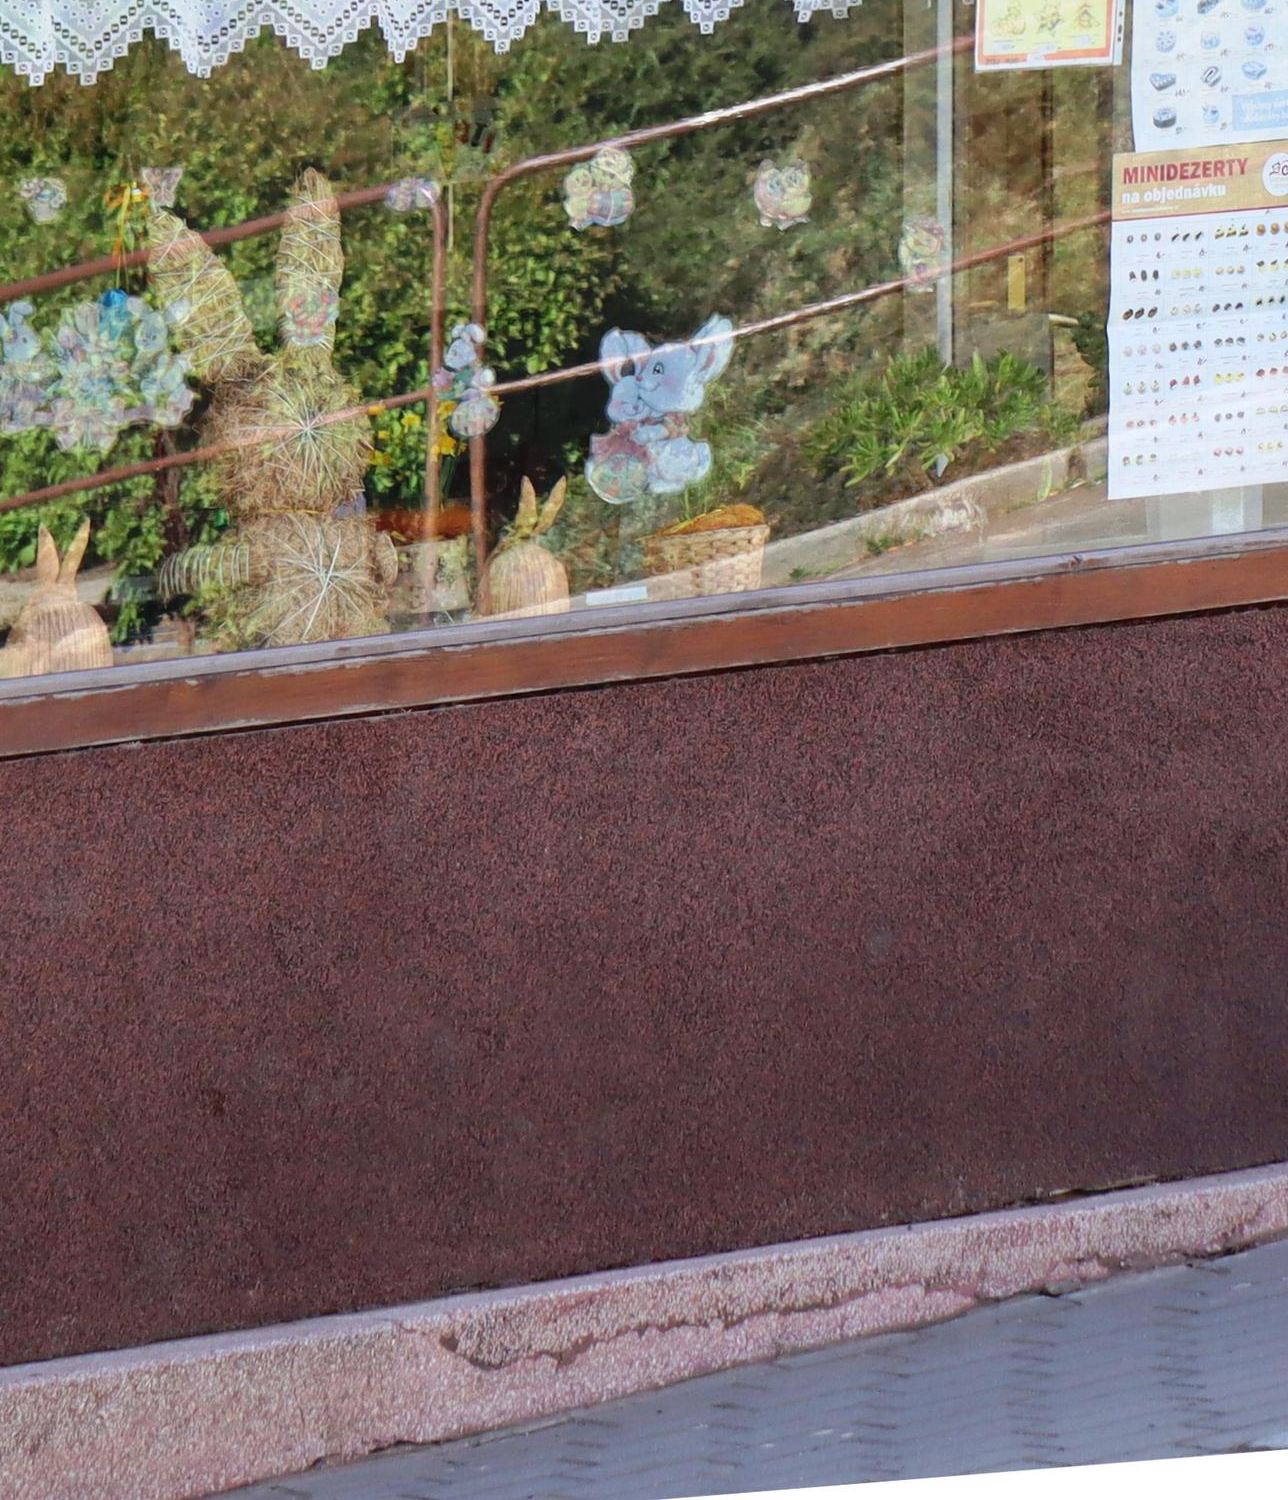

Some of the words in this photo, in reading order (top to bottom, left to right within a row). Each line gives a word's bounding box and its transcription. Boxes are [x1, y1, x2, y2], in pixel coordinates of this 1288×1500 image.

[1122, 157, 1249, 185] MINIDEZERTY
[1121, 191, 1140, 205] na
[1143, 183, 1227, 204] objednávku
